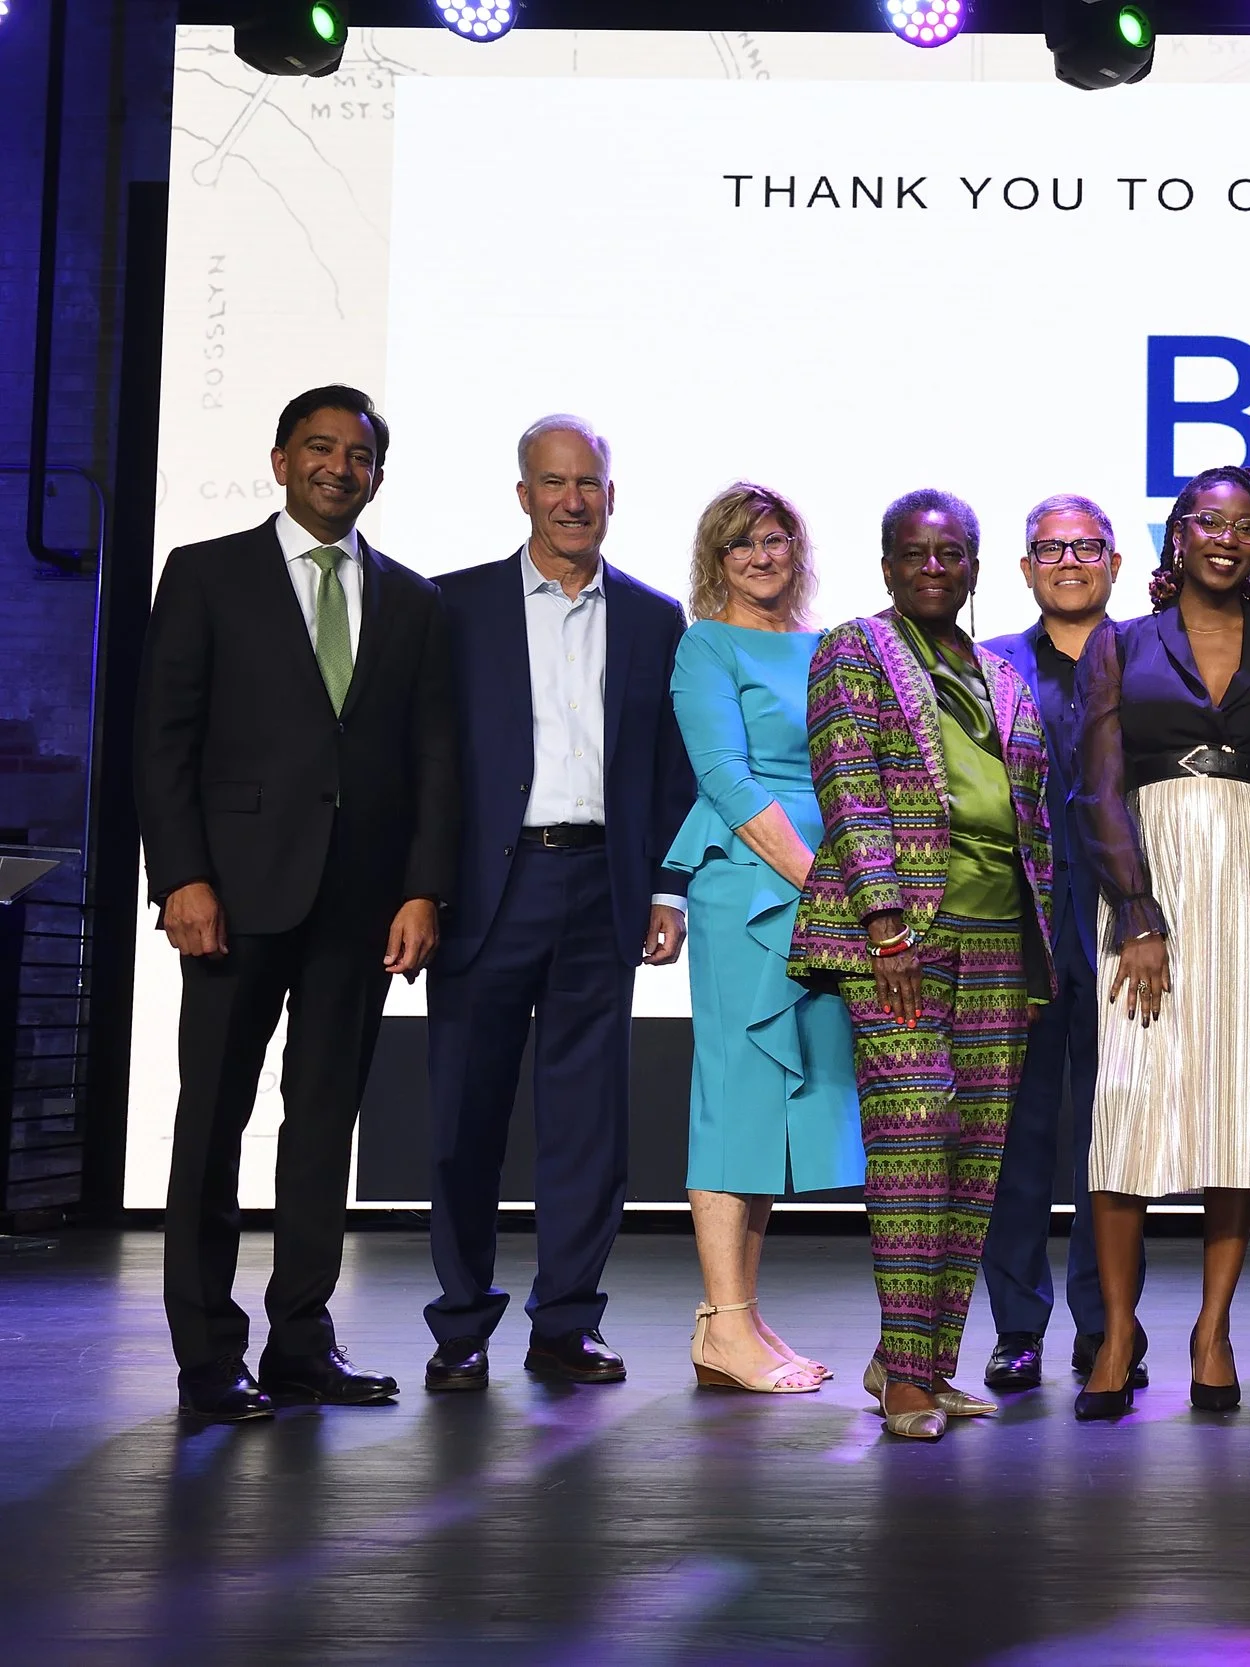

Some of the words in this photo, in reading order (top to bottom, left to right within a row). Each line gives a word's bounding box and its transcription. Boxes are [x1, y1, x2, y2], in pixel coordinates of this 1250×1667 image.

[311, 102, 331, 120] M
[723, 174, 928, 209] THANK
[960, 176, 1083, 211] YOU
[1117, 177, 1194, 212] TO
[202, 253, 228, 411] ROSSLYN
